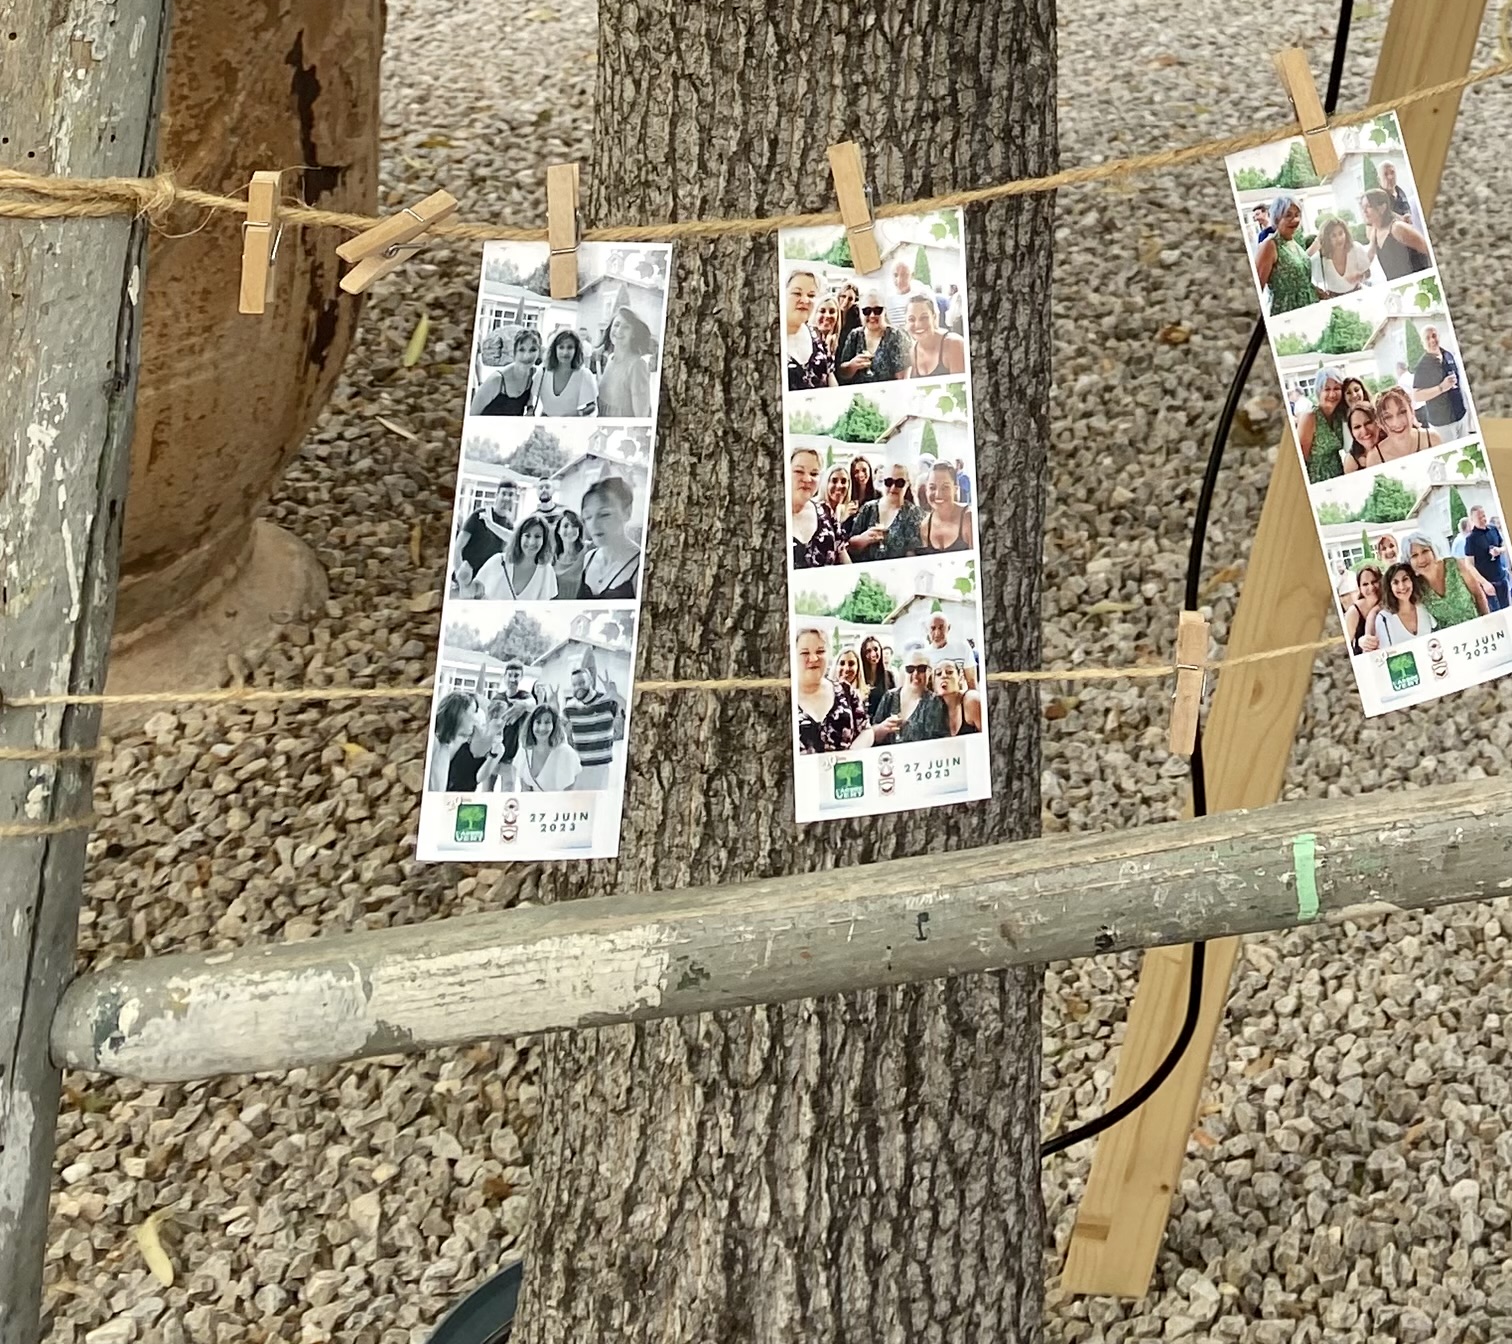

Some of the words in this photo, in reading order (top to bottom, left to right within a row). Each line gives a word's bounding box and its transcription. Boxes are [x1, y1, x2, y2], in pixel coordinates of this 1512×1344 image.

[1453, 642, 1467, 654] 27
[1475, 630, 1505, 647] JUIN
[1466, 643, 1497, 660] 2023
[904, 763, 920, 773] 27
[927, 757, 960, 770] JUIN
[916, 769, 950, 781] 2023
[530, 813, 546, 822] 27
[553, 812, 589, 822] JUIN
[540, 823, 576, 832] 2023
